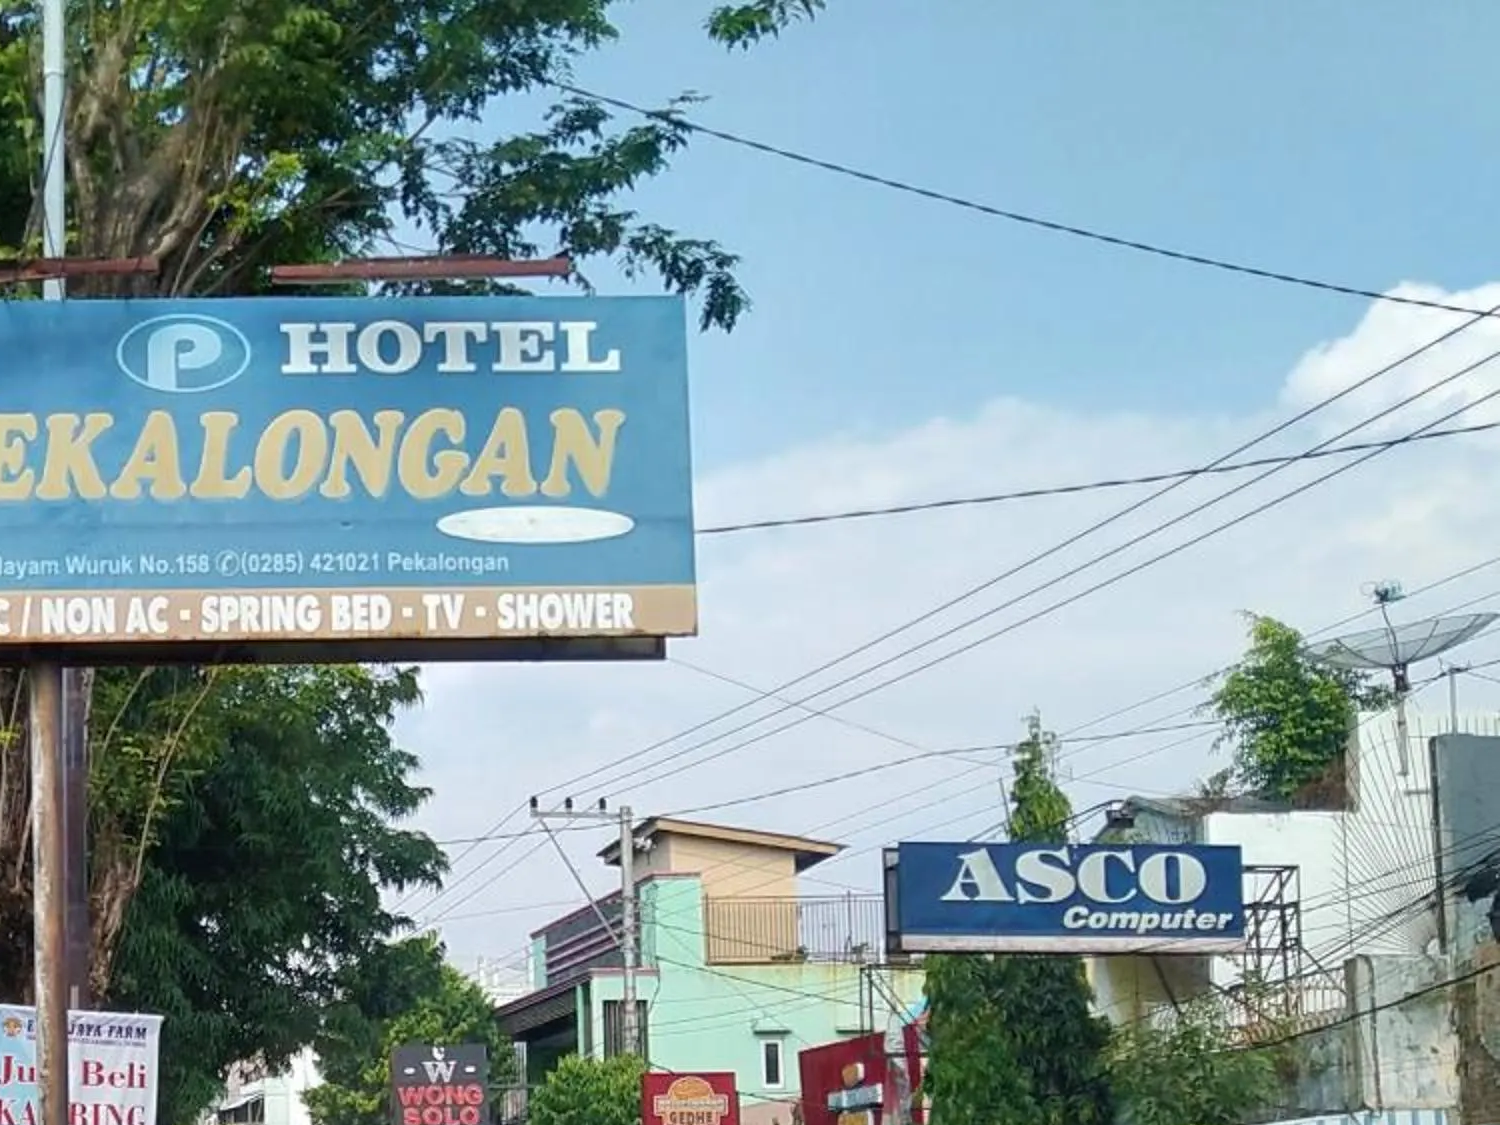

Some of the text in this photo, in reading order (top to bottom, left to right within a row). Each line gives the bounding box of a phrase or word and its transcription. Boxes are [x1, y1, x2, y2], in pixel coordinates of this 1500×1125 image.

[280, 320, 621, 374] HOTEL
[65, 555, 132, 575] Wuruk
[139, 554, 210, 575] No.158
[241, 551, 304, 575] (0285)
[309, 552, 380, 573] 421021
[387, 552, 509, 575] Pekalongan
[40, 597, 116, 635] NON
[125, 596, 170, 634] AC
[201, 594, 322, 632] SPRING
[331, 594, 392, 631] BED
[422, 593, 465, 630] TV
[497, 593, 636, 629] SHOWER
[940, 846, 1208, 904] ASCO
[1062, 906, 1234, 931] Computer
[107, 1025, 147, 1040] FARM
[82, 1060, 147, 1089] Beli
[397, 1084, 484, 1105] WONG
[670, 1111, 712, 1125] GEDHE
